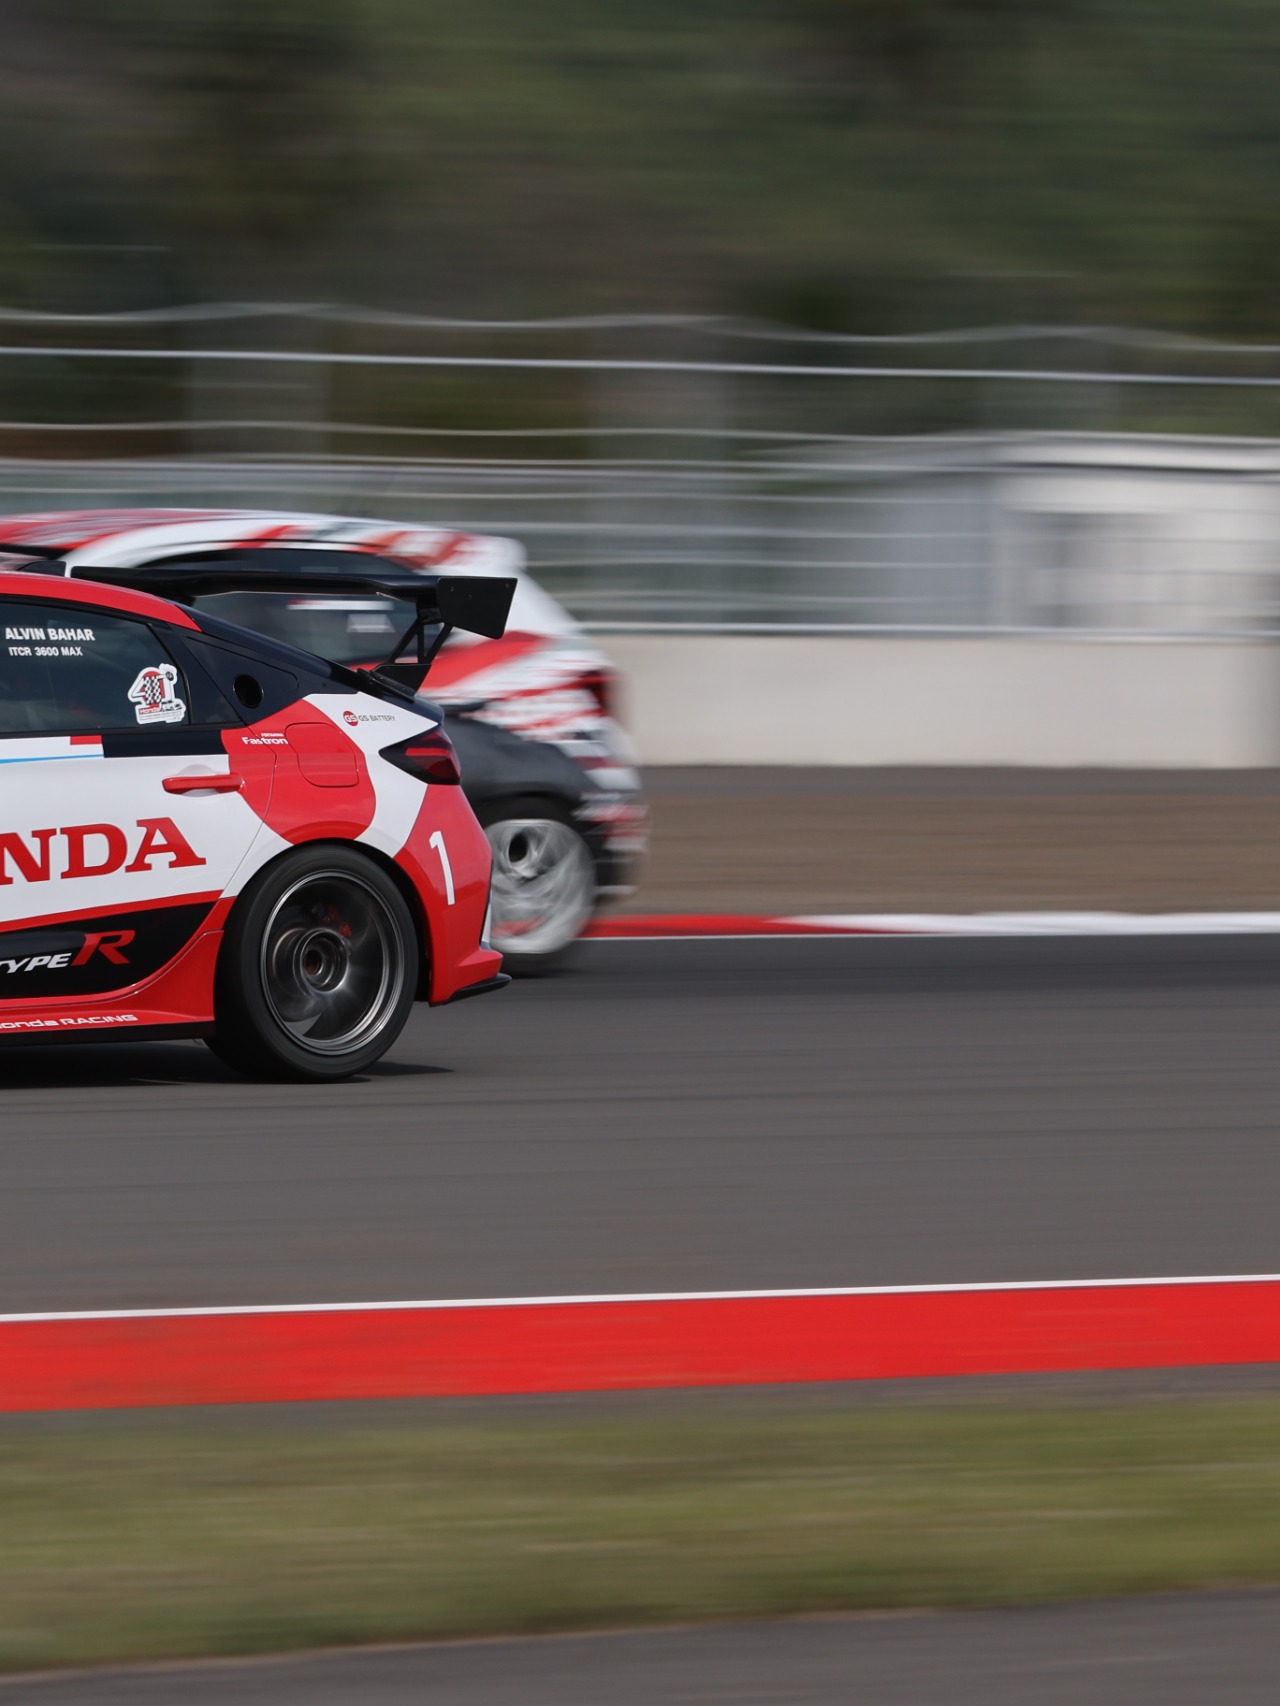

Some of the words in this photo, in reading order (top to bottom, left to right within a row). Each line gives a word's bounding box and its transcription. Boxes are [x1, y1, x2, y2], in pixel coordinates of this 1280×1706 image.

[5, 627, 46, 641] ALVIN
[47, 628, 96, 641] BAHAR
[8, 646, 32, 656] ITCR
[34, 646, 60, 656] 3600
[61, 646, 83, 656] MAX
[241, 736, 289, 745] Fastron
[429, 831, 455, 905] 1
[71, 929, 136, 967] R
[59, 1013, 139, 1027] RACING
